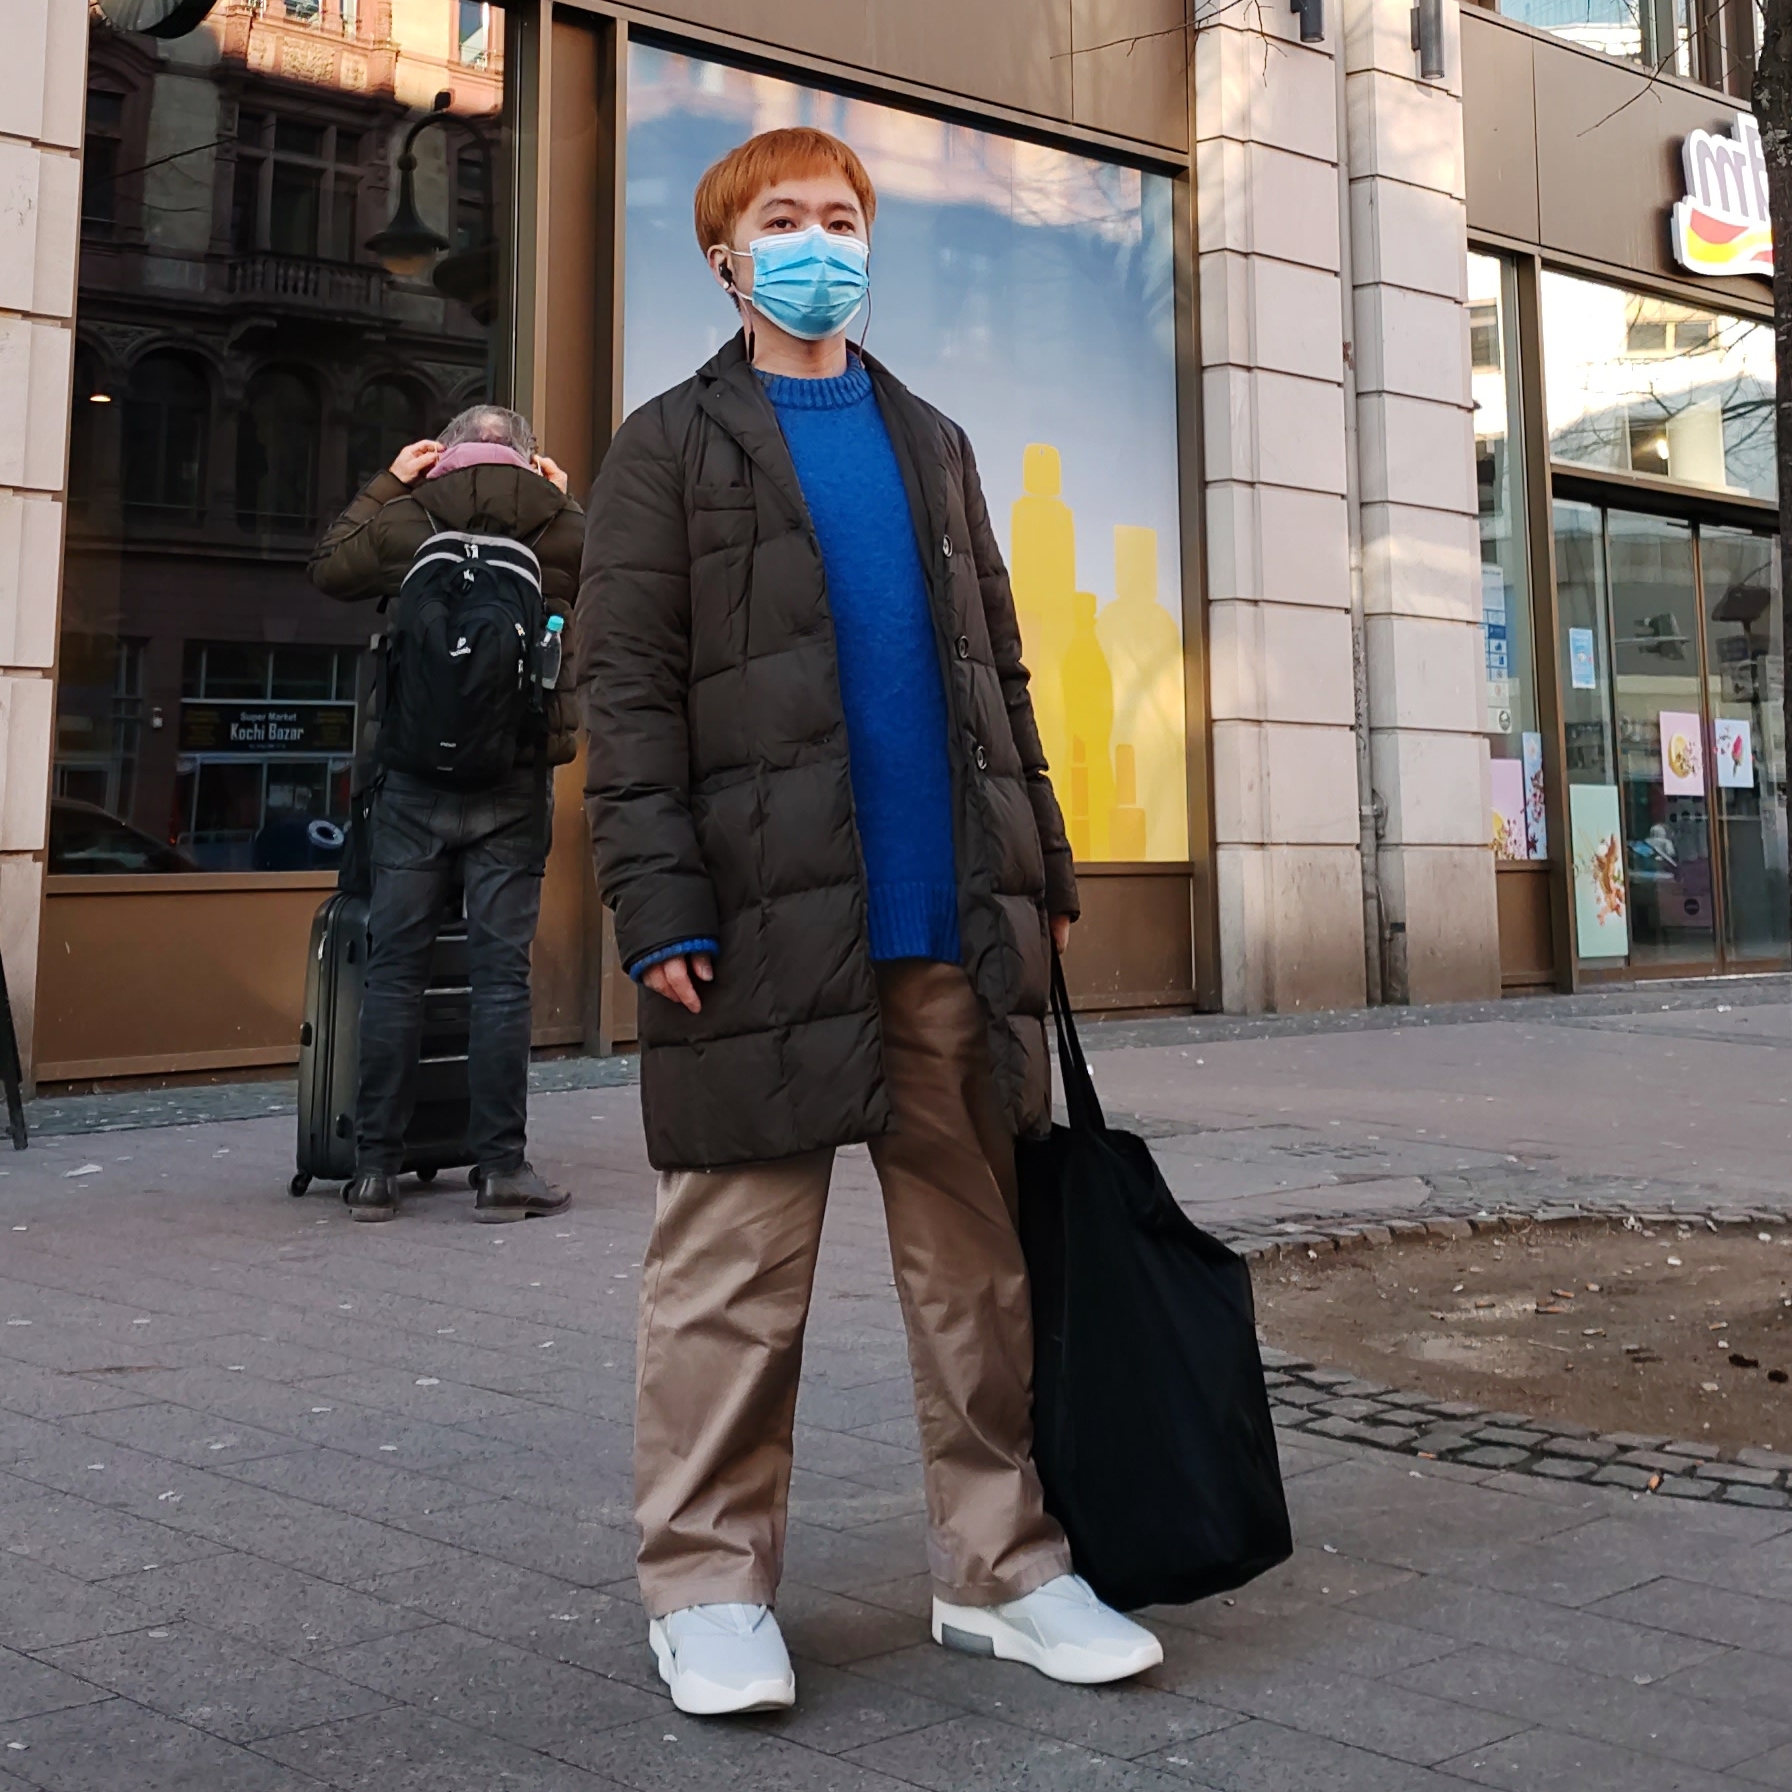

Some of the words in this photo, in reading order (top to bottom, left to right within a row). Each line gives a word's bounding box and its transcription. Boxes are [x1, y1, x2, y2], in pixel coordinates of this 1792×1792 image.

[240, 711, 266, 722] Super
[268, 711, 297, 721] Market
[230, 722, 265, 741] Kochi
[268, 723, 304, 741] Bazar
